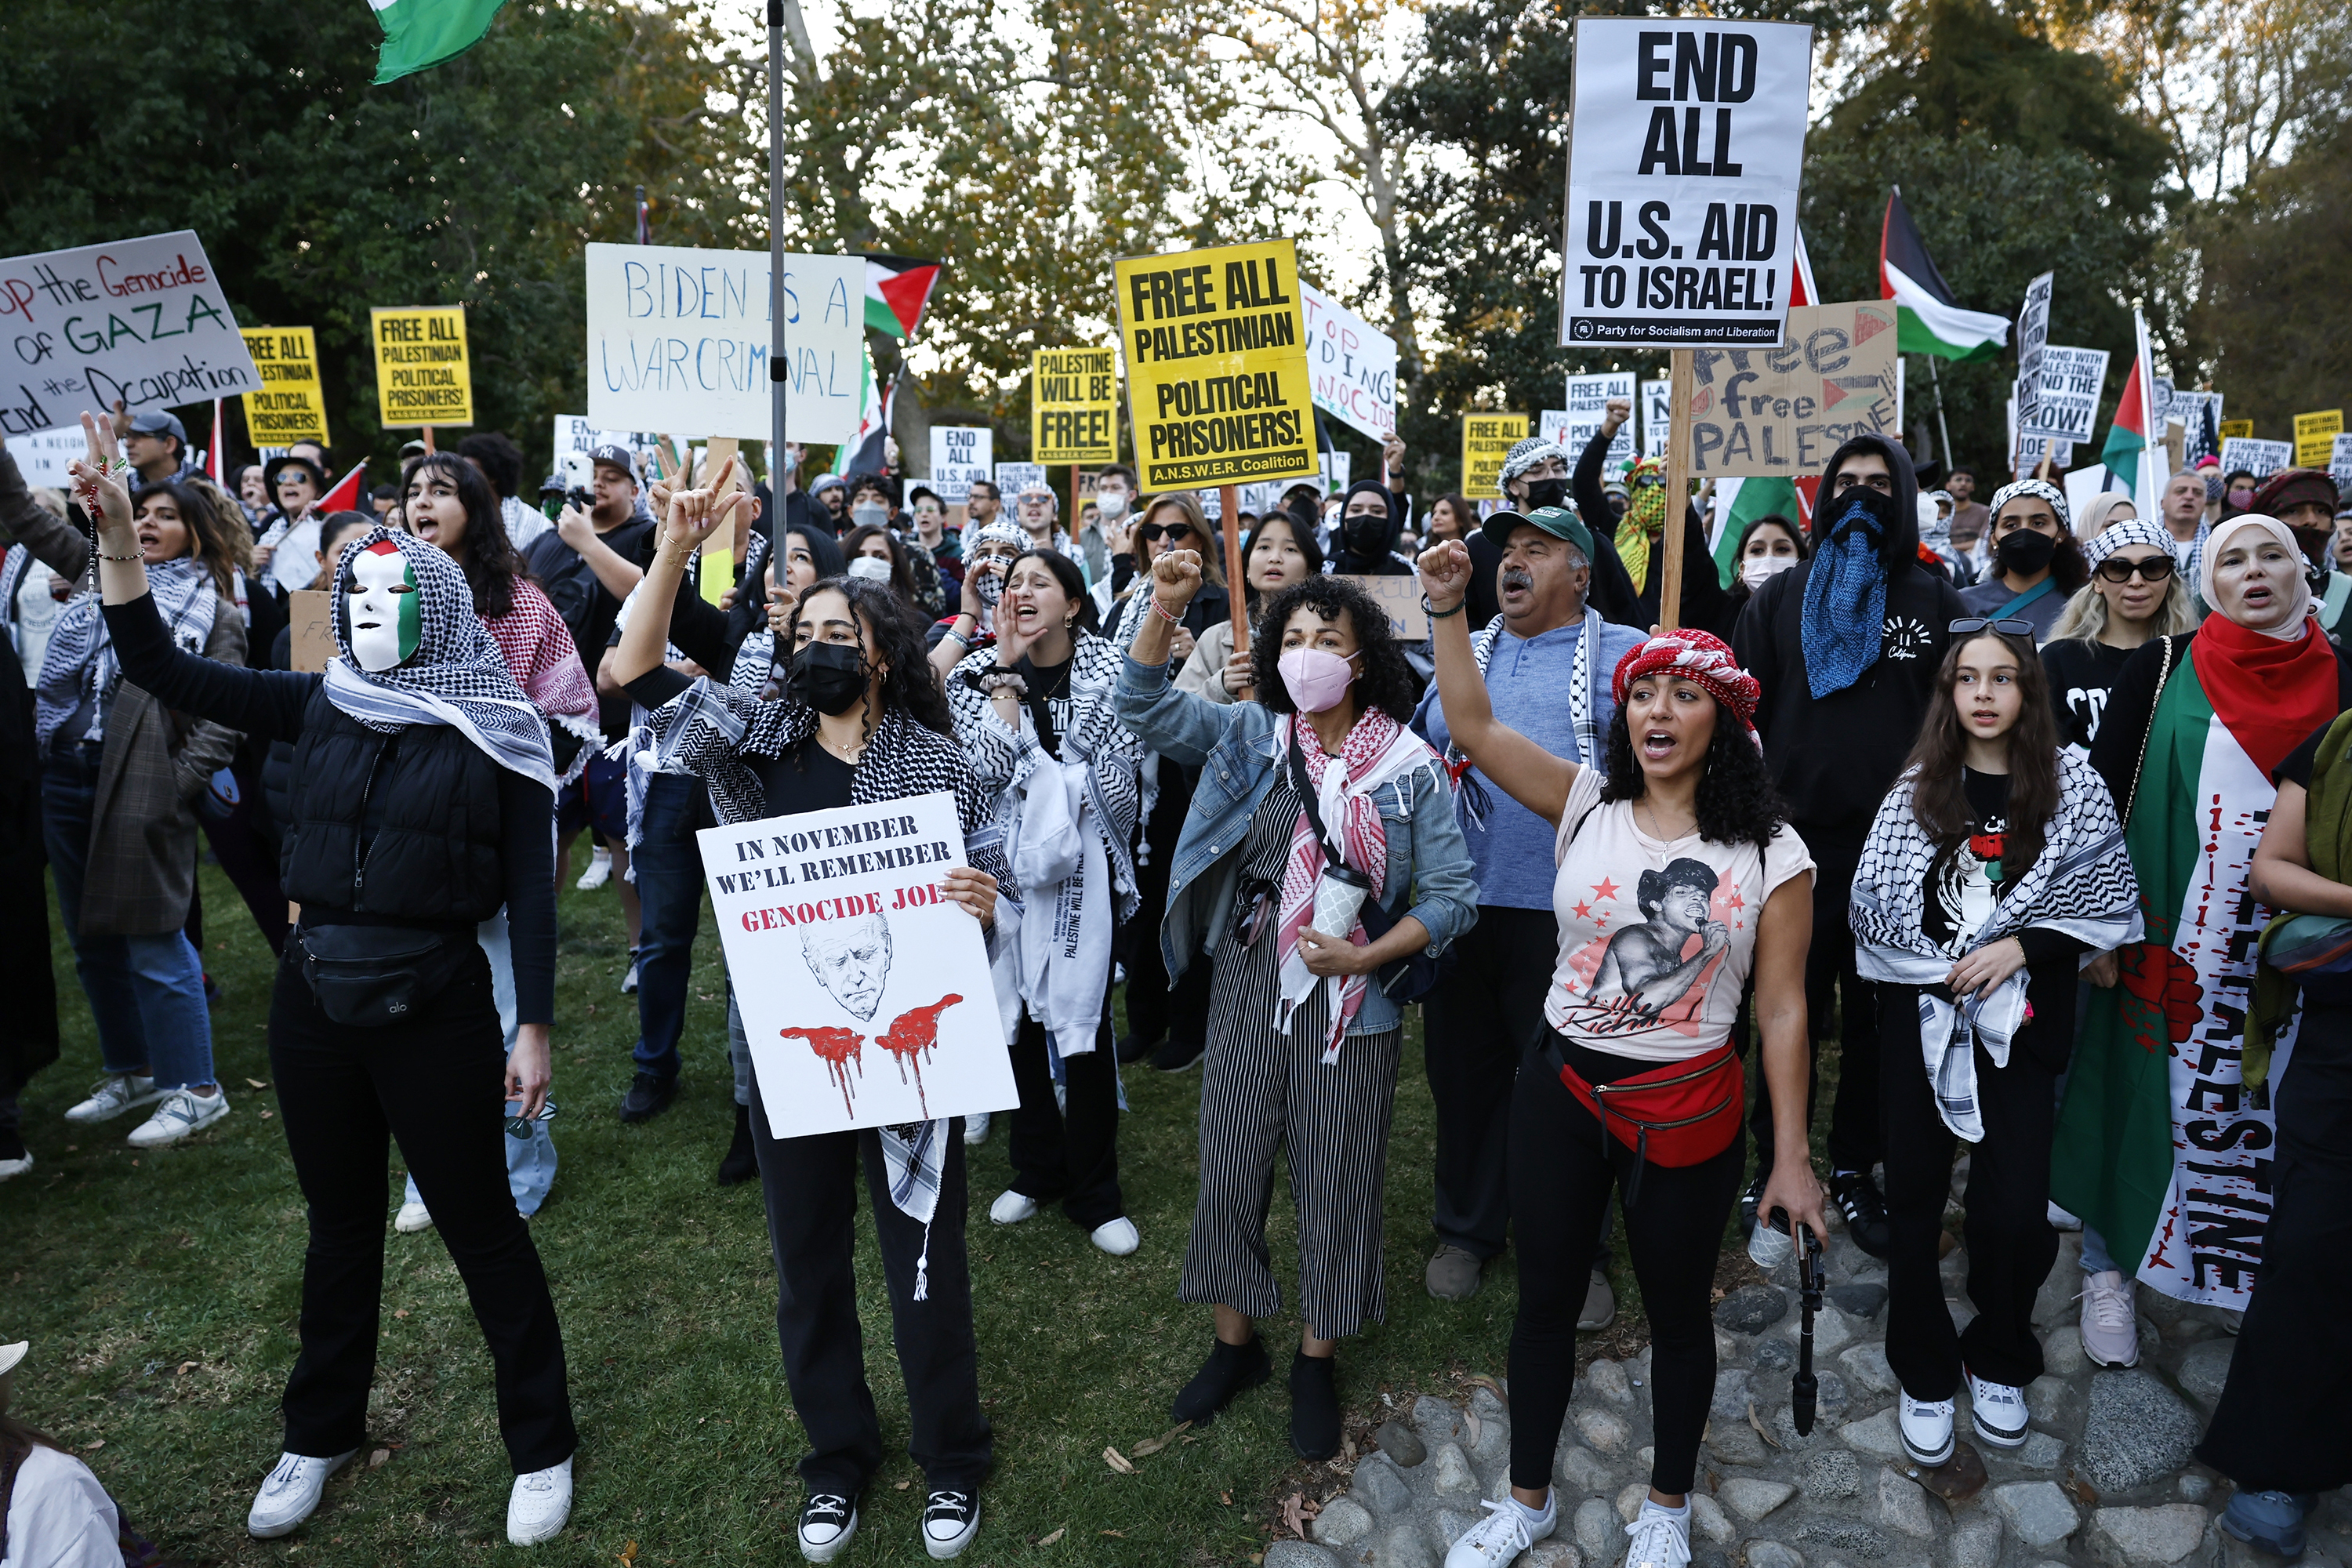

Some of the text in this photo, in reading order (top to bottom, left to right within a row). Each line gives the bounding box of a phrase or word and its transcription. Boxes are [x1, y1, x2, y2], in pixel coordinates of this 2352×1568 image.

[1636, 31, 1758, 103] END
[1638, 107, 1743, 177] ALL
[1587, 201, 1778, 261] U.S. AID
[34, 264, 99, 306] the
[96, 254, 206, 297] Genocide
[1130, 257, 1290, 321] FREE ALL
[1580, 265, 1776, 310] TO ISRAEL!
[625, 261, 746, 319] BIDEN
[824, 277, 848, 327] A
[64, 294, 227, 354] GAZA
[380, 317, 459, 342] FREE ALL
[1305, 296, 1359, 353] TOP
[1597, 325, 1627, 337] Party
[1630, 326, 1646, 336] for
[1649, 326, 1701, 336] Socialism
[1704, 327, 1723, 337] and
[1726, 328, 1775, 337] Liberation
[280, 336, 309, 359] ALL
[1134, 311, 1295, 363] PALESTINIAN
[383, 344, 461, 363] PALESTINIAN
[1040, 353, 1111, 374] PALESTINE
[2043, 350, 2103, 364] TAND WITH
[256, 364, 313, 381] LESTINIAN
[392, 368, 456, 386] POLITICAL
[2042, 361, 2100, 376] ALESTINE!
[43, 377, 85, 397] the
[84, 354, 249, 413] Occupation
[1040, 376, 1110, 401] WILL BE
[1156, 371, 1287, 419] POLITICAL
[1571, 381, 1630, 397] FREE ALL
[1721, 372, 1816, 419] free
[2041, 374, 2098, 394] ND THE
[254, 393, 310, 410] POLITICAL
[387, 388, 463, 406] PRISONERS!
[1311, 390, 1350, 421] AZA
[1318, 375, 1396, 432] NOCIDE
[2040, 395, 2093, 409] CUPATION
[946, 431, 975, 447] END
[1041, 410, 1109, 448] FREE!
[1149, 409, 1303, 459] PRISONERS!
[1469, 422, 1523, 437] FREE ALL
[47, 437, 85, 449] NEIGH
[949, 448, 974, 463] ALL
[2229, 441, 2288, 453] STAND WITH
[937, 469, 986, 482] U.S. AID
[1153, 462, 1239, 481] A.N.S.W.E.R.
[1241, 456, 1305, 472] Coalition
[303, 621, 334, 641] FR
[735, 815, 919, 862] IN NOVEMBER
[716, 841, 952, 895] WE'LL REMEMBER
[1073, 876, 1083, 887] BE
[742, 883, 946, 933] GENOCIDE JOE
[1070, 890, 1083, 911] WILL
[1064, 912, 1081, 959] PALESTINE
[389, 1001, 408, 1014] alo
